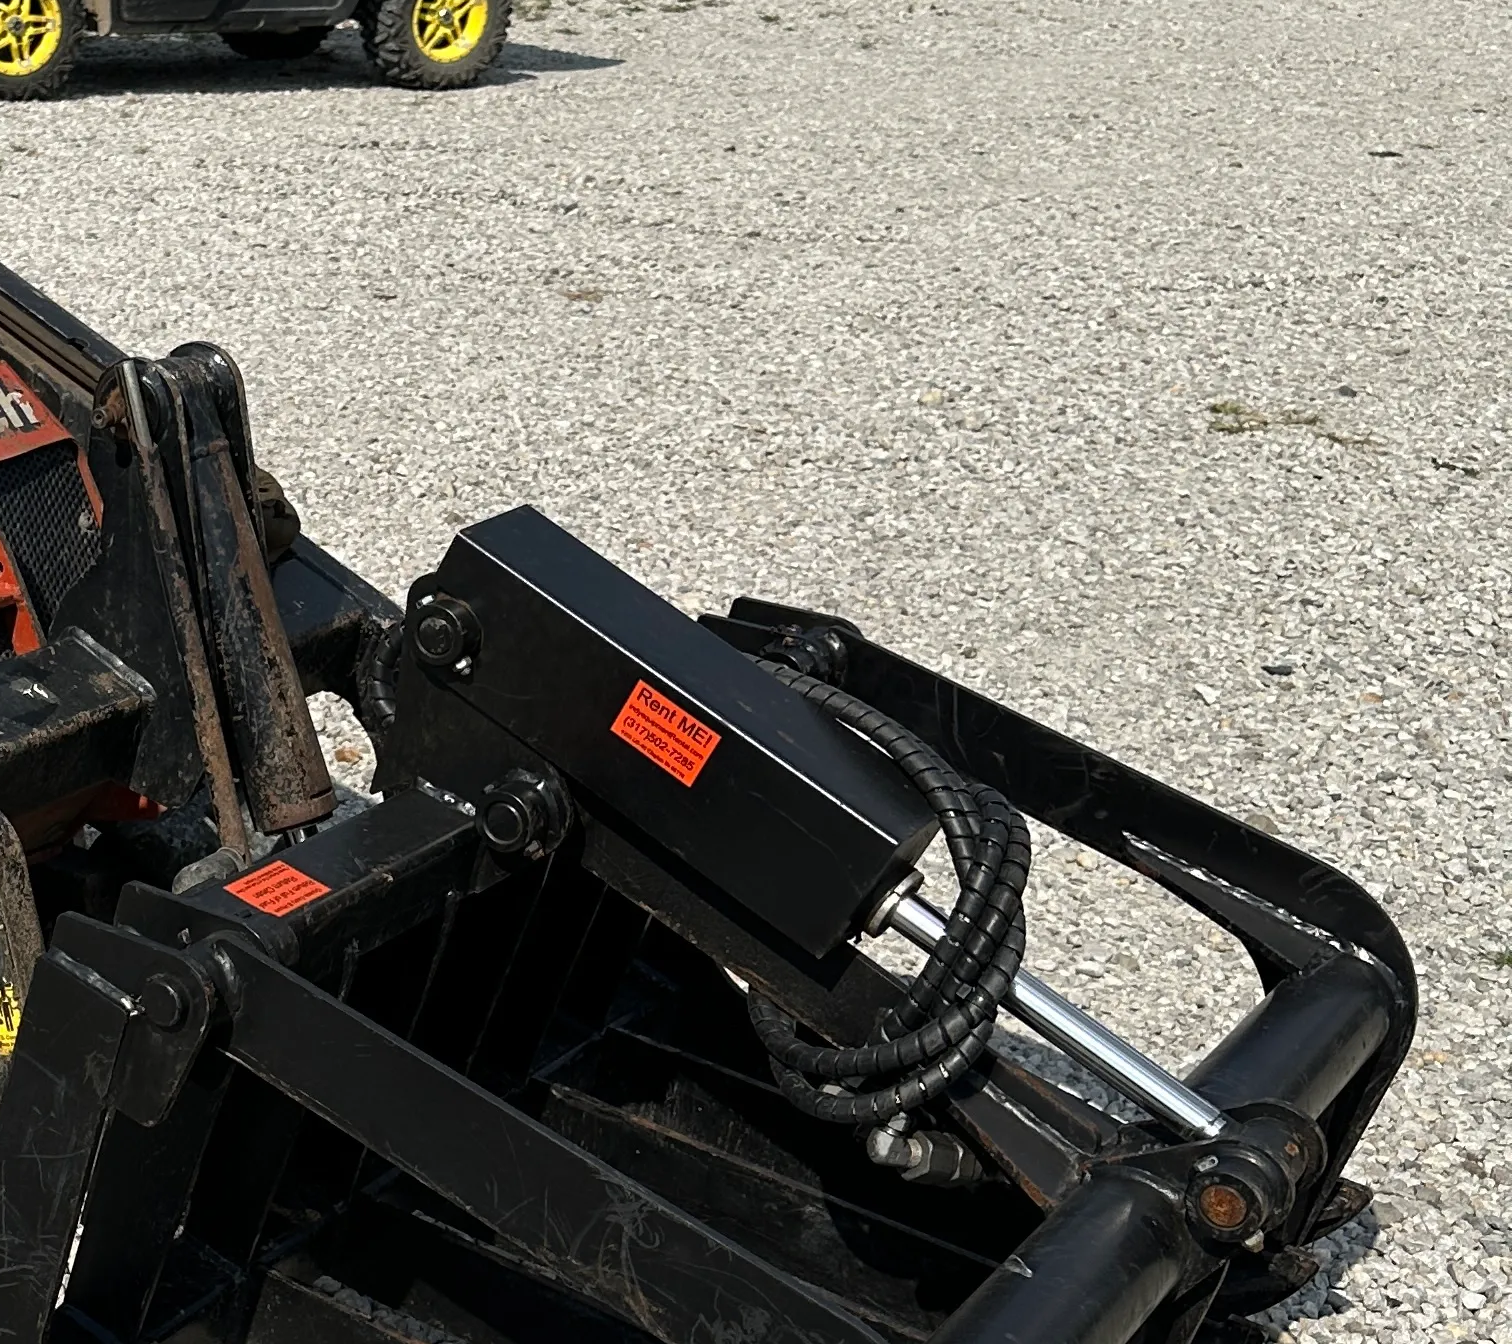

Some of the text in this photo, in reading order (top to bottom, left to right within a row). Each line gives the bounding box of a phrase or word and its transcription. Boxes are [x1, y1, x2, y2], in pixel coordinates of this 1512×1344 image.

[623, 716, 695, 772] (317)502-7285
[637, 687, 713, 749] Rent ME!
